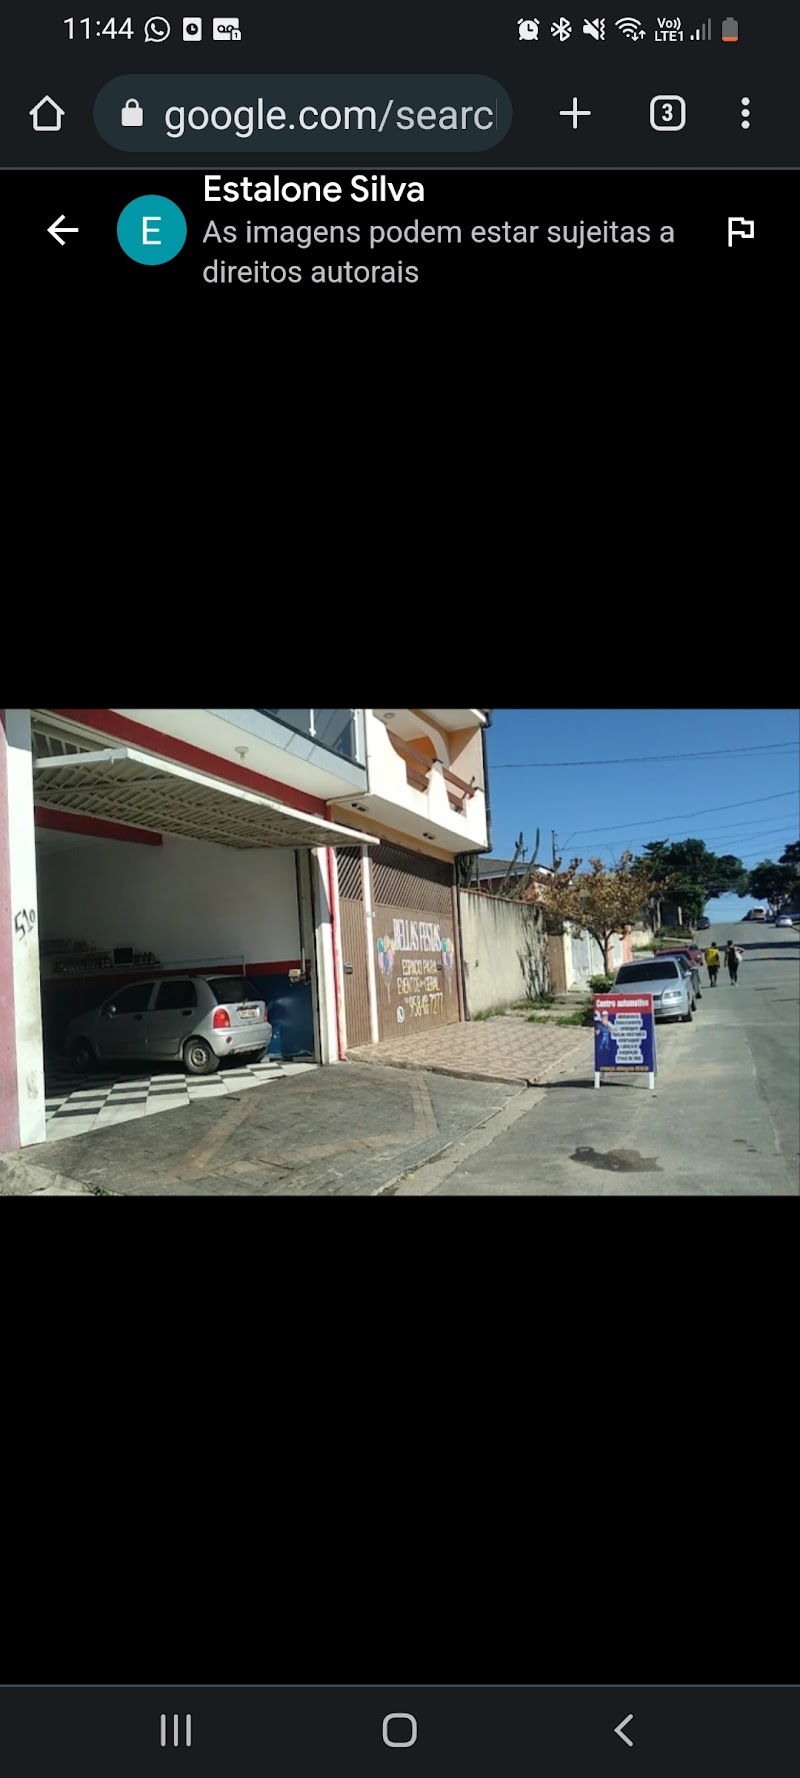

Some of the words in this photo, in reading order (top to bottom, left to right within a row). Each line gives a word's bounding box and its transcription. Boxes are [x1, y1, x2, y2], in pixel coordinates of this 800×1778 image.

[393, 918, 419, 951] BELLAS
[419, 922, 442, 952] FESTAS
[596, 999, 616, 1008] Centro
